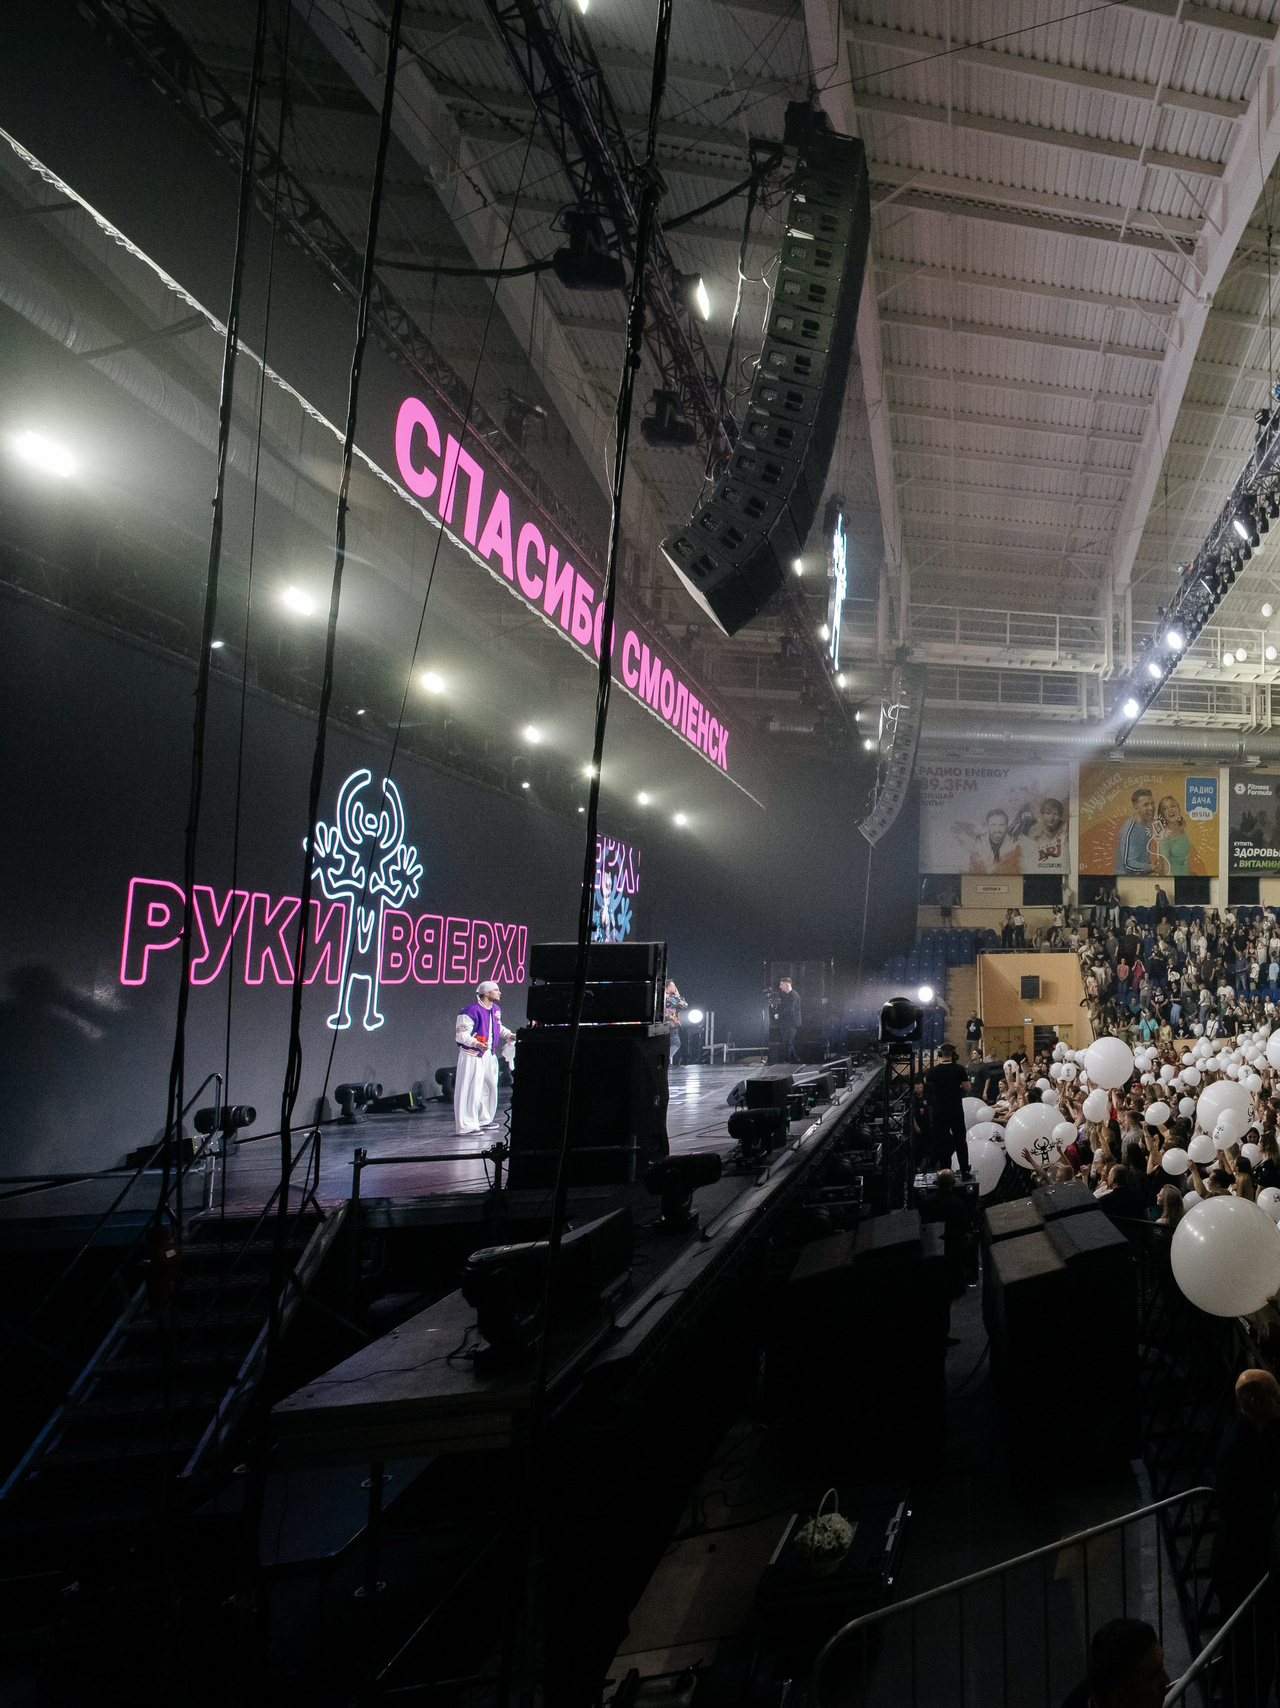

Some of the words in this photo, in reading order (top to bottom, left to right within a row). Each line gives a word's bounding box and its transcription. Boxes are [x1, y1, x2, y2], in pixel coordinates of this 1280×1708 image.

[394, 396, 616, 660] СПАСИБО
[621, 630, 729, 771] СМОЛЕНСК
[919, 766, 962, 778] РАДИО
[965, 768, 1009, 778] ENERGY
[1189, 786, 1214, 794] РАДИО
[1191, 796, 1212, 804] ДАЧА
[119, 876, 347, 986] РУКИ
[379, 909, 528, 985] ВВЕРХ!
